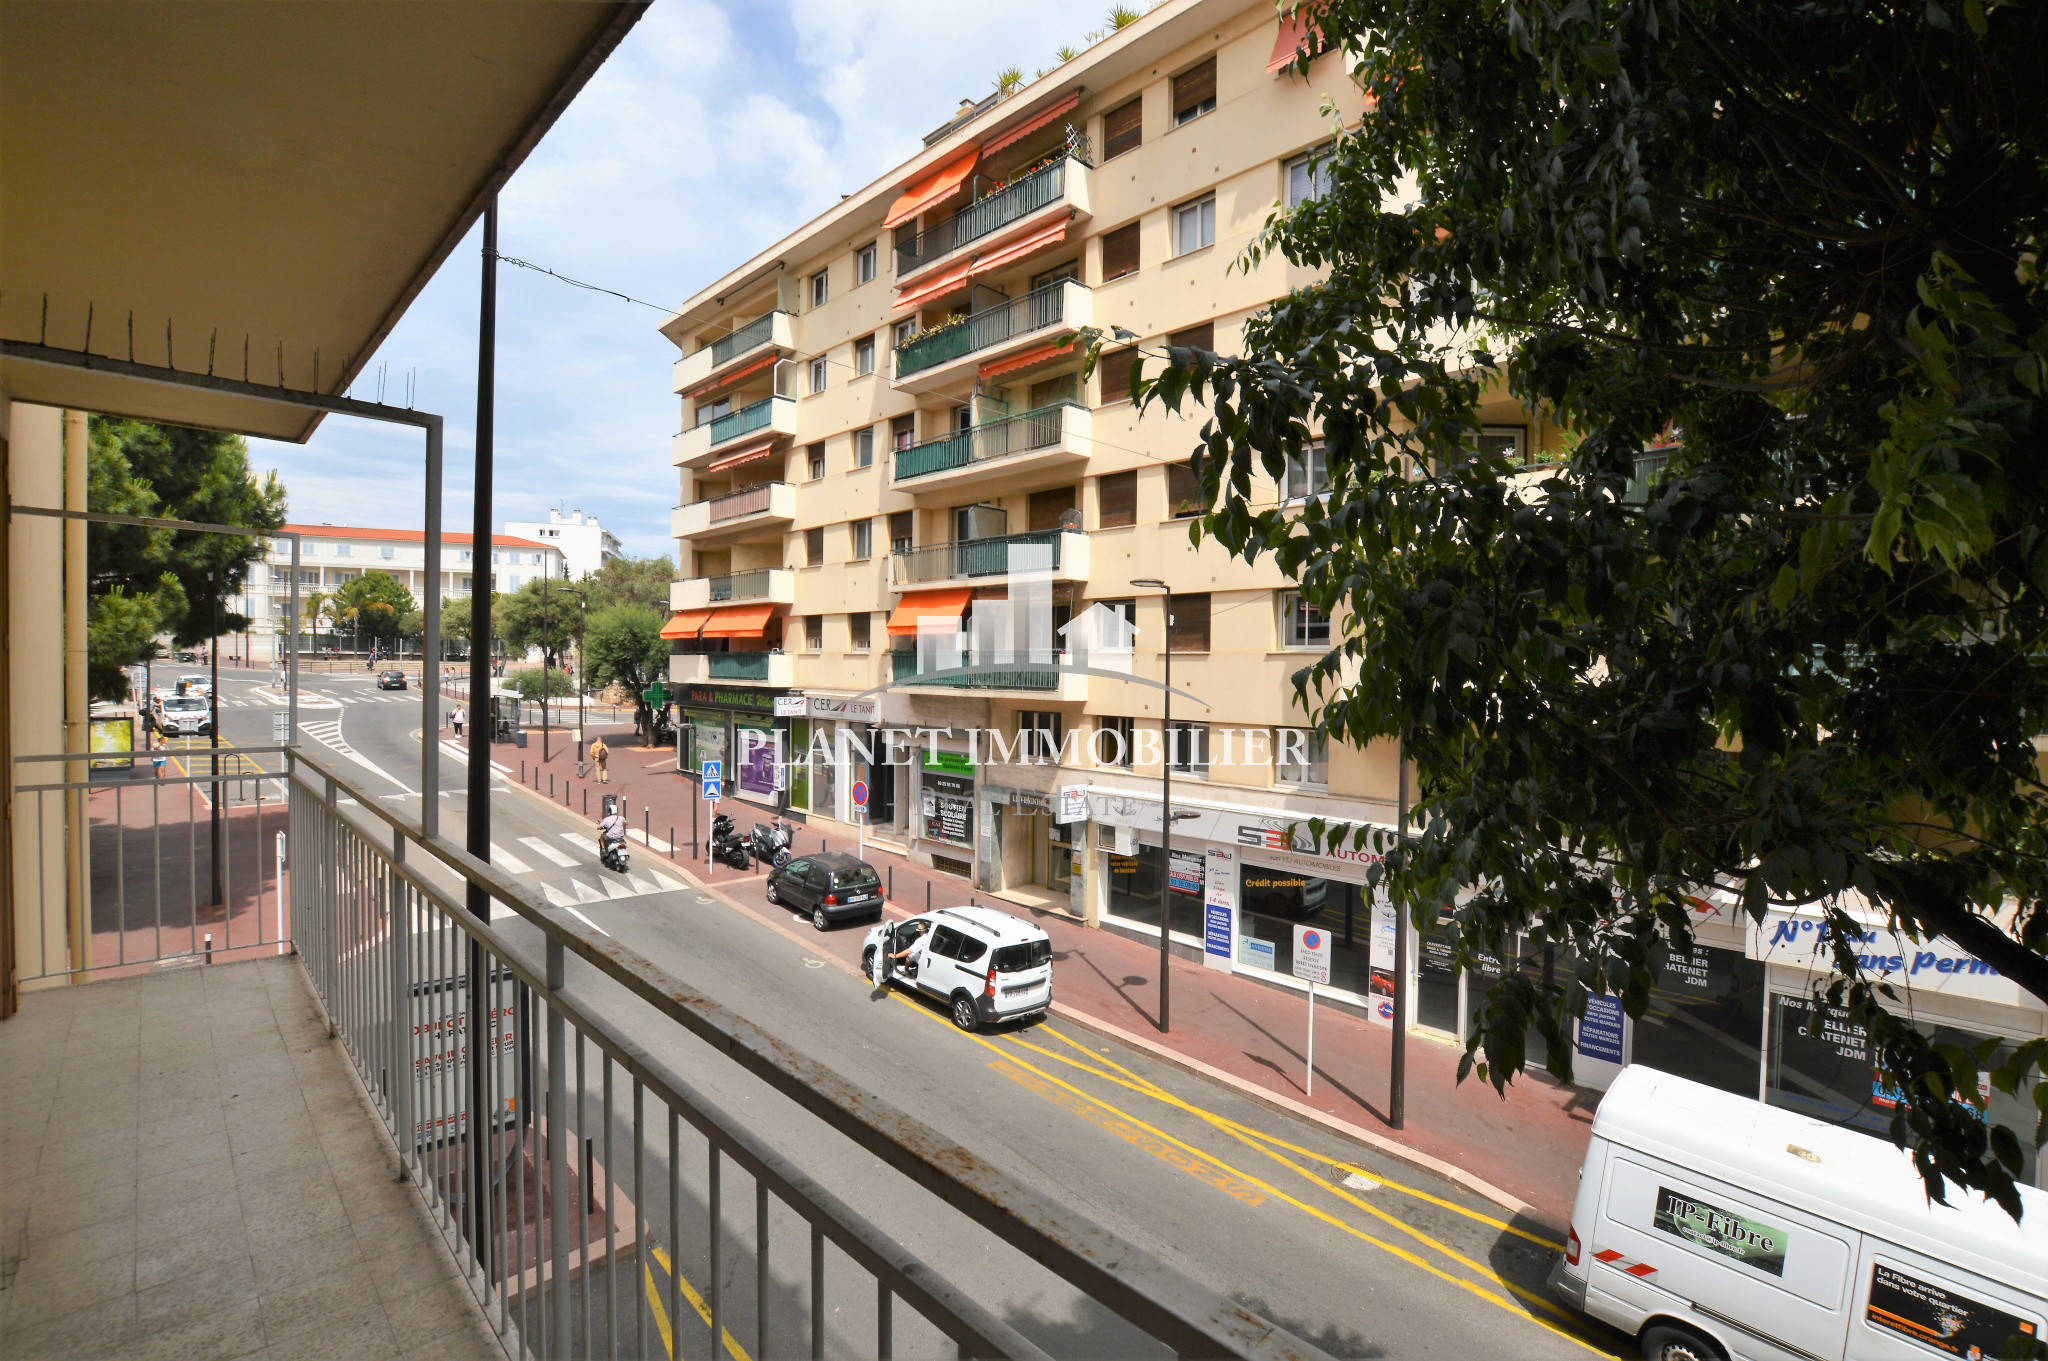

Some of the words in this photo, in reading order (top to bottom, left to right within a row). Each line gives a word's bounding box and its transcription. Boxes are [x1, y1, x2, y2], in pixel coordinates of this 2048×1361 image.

[692, 690, 706, 702] PARA
[715, 691, 753, 706] PHARMACIE
[851, 704, 857, 713] LE
[858, 704, 875, 715] TANIT
[940, 801, 967, 813] SOUTIEN
[940, 809, 967, 821] SCOLAIRE
[1293, 858, 1341, 872] AUTOMOBILES
[1245, 879, 1271, 887] Crédit
[1272, 879, 1305, 889] possible
[1482, 963, 1501, 974] libre
[1663, 962, 1708, 977] HATENET
[1833, 952, 1902, 972] ans
[1910, 951, 2000, 976] Perm
[1685, 976, 1707, 987] JDM
[1587, 997, 1616, 1009] VÉHICULES
[1779, 996, 1802, 1009] Nos
[1798, 1026, 1866, 1049] CATENET
[1580, 1041, 1620, 1056] FINANCEMENTS
[1836, 1047, 1866, 1062] JDM
[1666, 1195, 1775, 1252] IP-Fibre
[1878, 1267, 1891, 1278] La
[1892, 1272, 1917, 1288] Fibre
[1918, 1284, 1947, 1300] arrive
[1877, 1277, 1900, 1291] dans
[1902, 1287, 1927, 1301] votre
[1929, 1297, 1969, 1317] quartier
